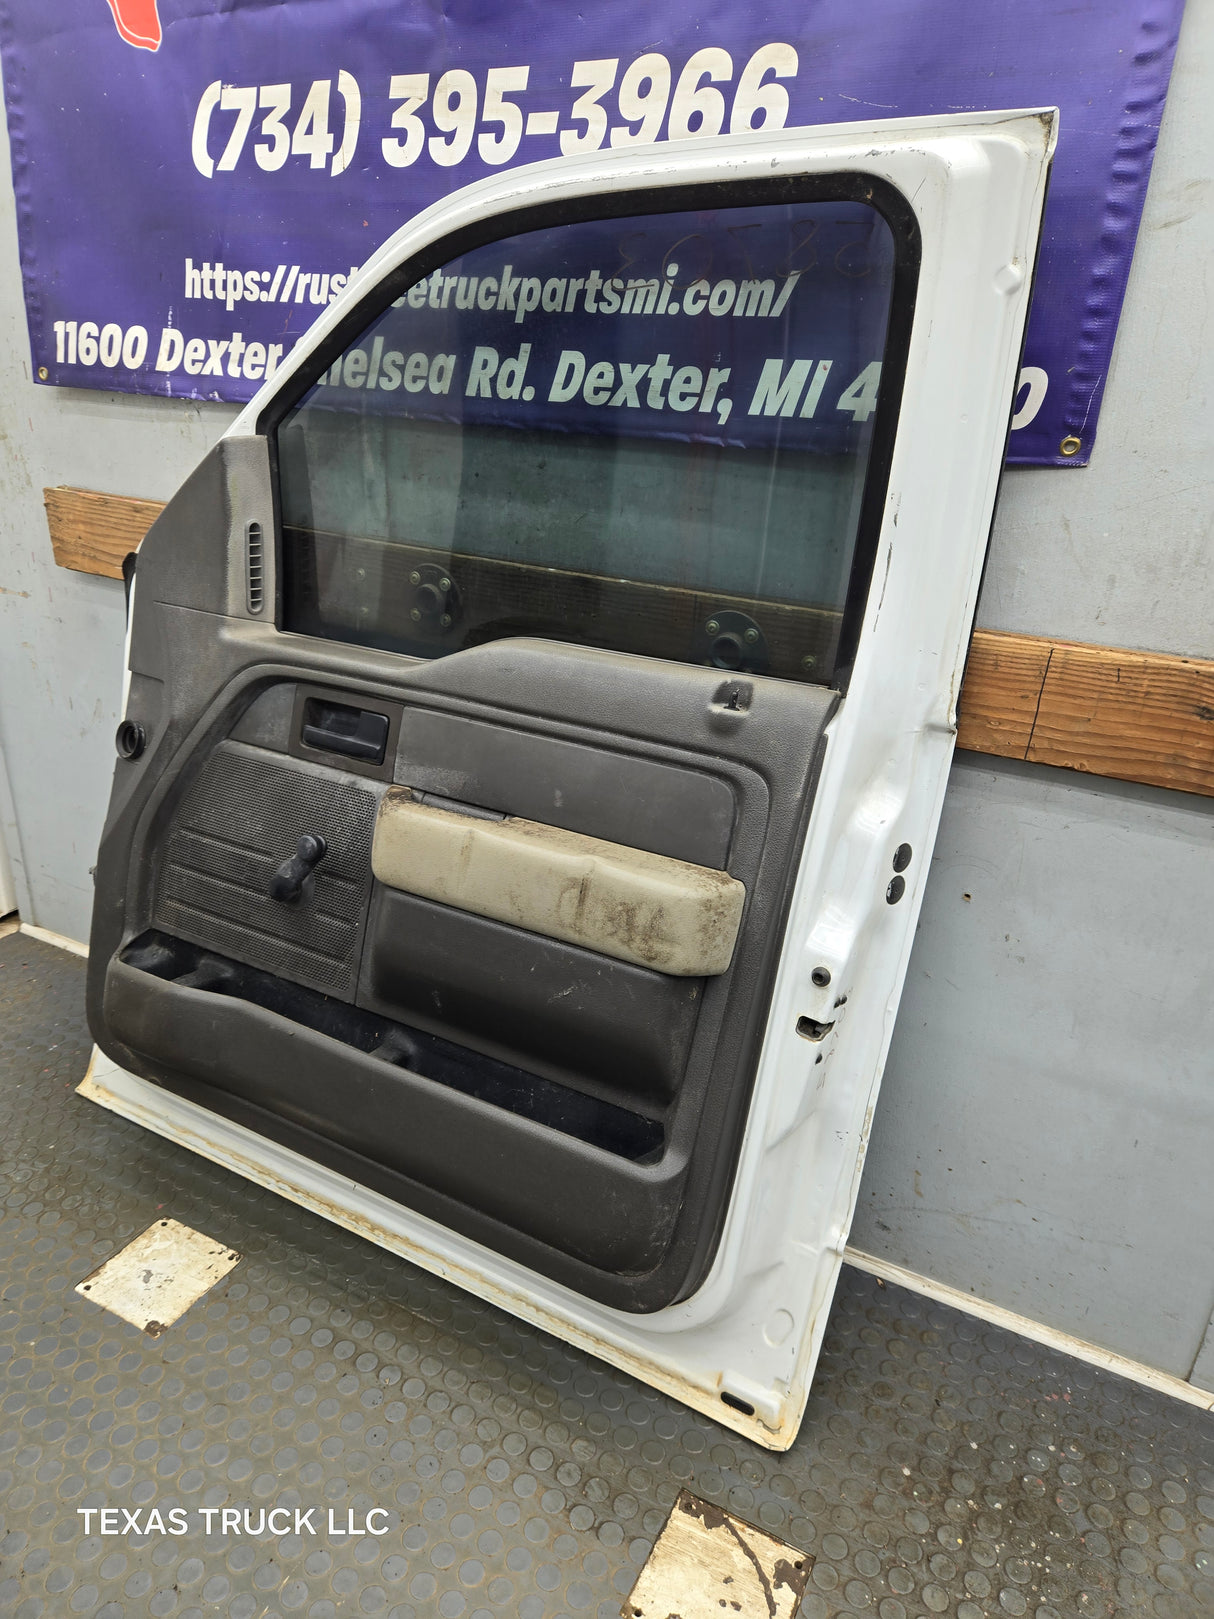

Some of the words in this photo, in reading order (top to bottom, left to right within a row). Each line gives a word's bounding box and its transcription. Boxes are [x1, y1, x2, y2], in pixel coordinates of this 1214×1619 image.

[191, 69, 362, 179] (734)
[381, 42, 799, 167] 395-3966
[53, 320, 149, 371] 11600
[155, 327, 284, 381] Dexter
[290, 334, 456, 396] elsea
[465, 343, 536, 401] Rd.
[547, 349, 733, 426] Dexter,
[747, 357, 833, 419] MI
